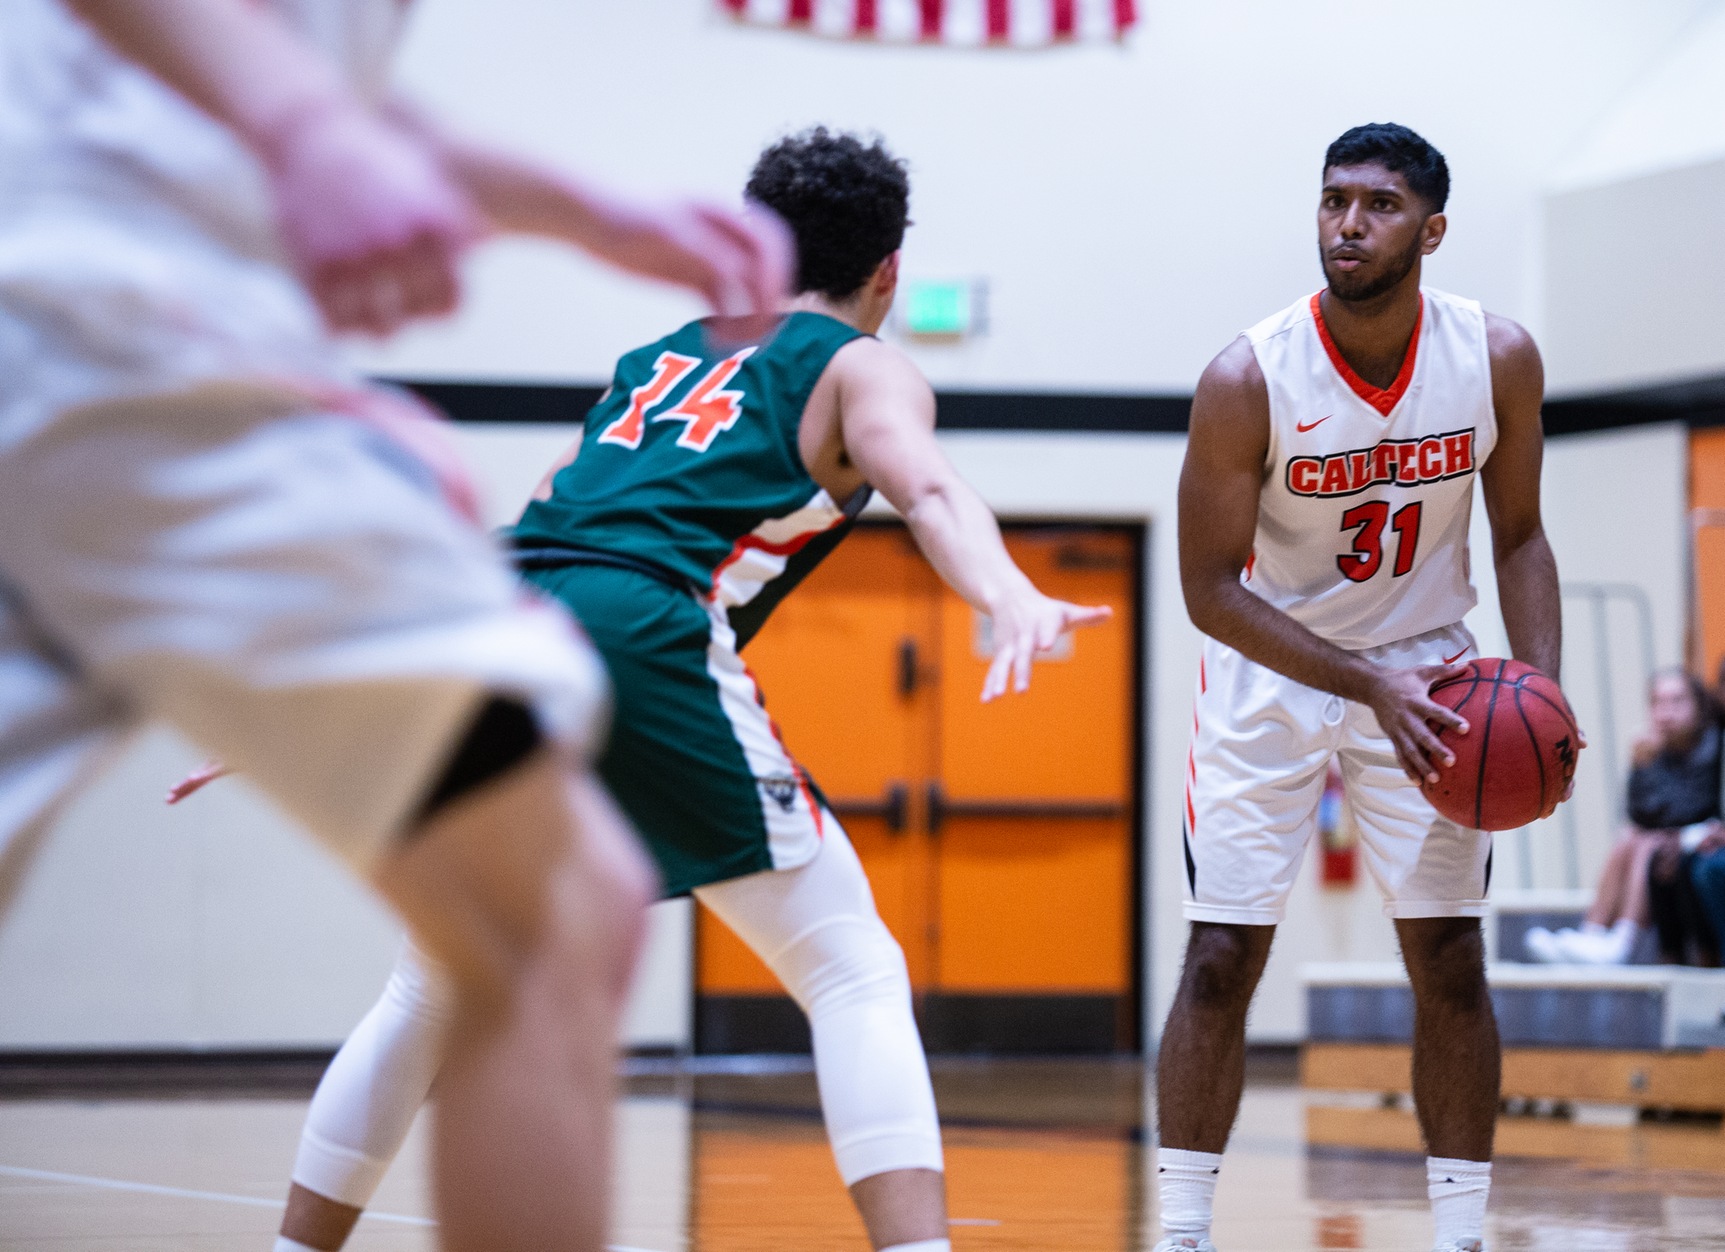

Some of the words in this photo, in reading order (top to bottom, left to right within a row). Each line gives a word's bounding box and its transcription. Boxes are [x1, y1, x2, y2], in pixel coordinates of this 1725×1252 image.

[598, 346, 759, 453] 14
[1286, 427, 1475, 498] CALTECH
[1337, 500, 1423, 583] 31
